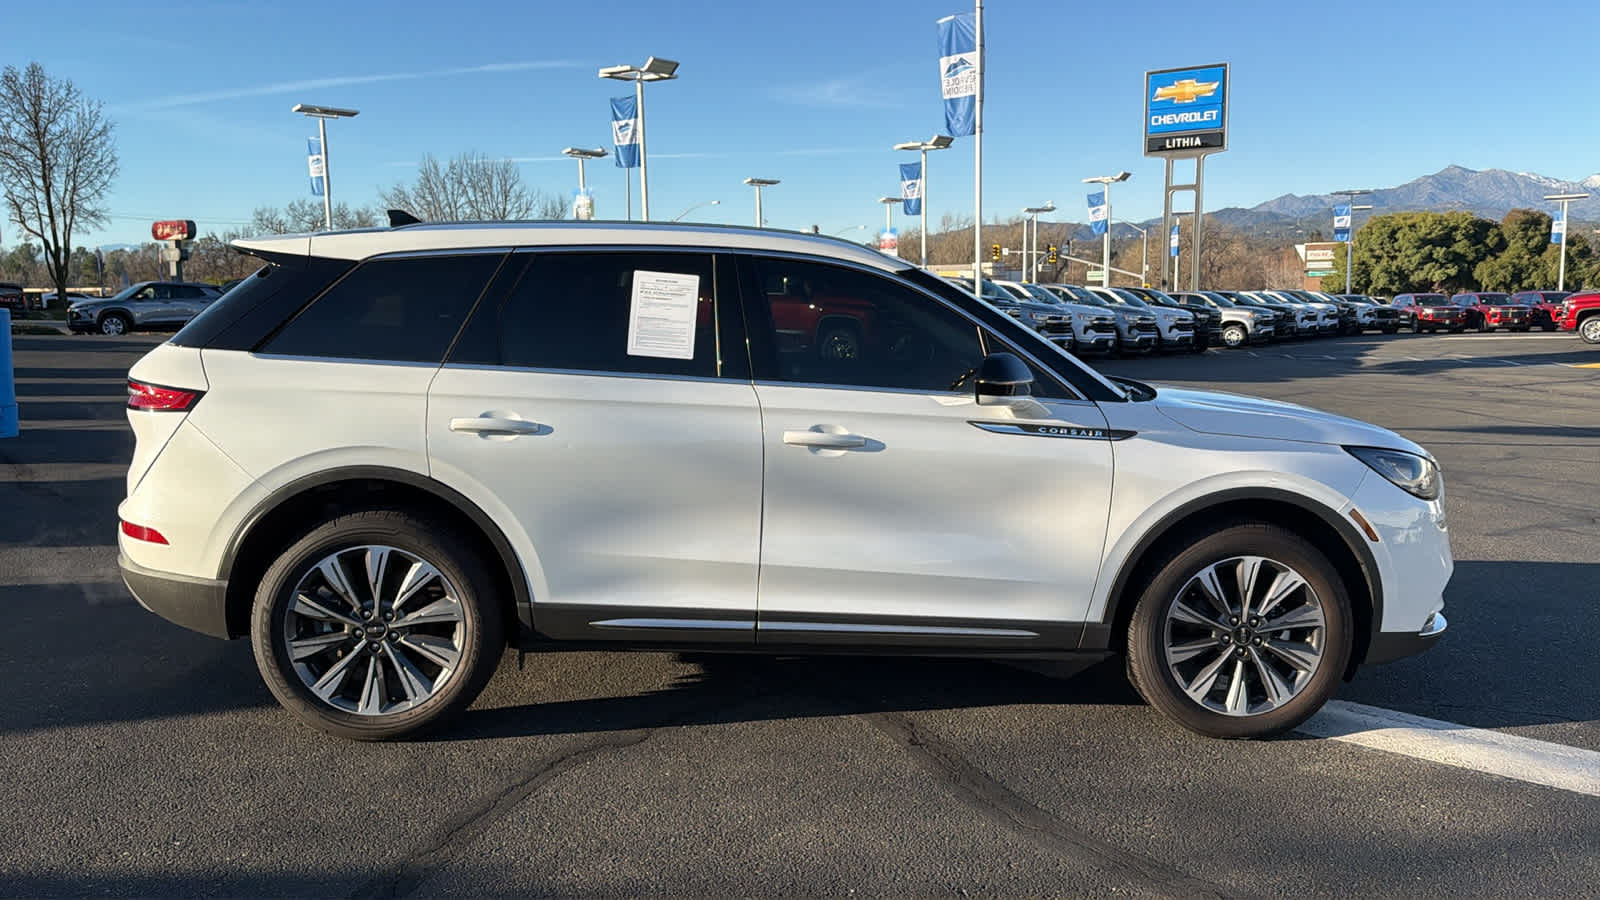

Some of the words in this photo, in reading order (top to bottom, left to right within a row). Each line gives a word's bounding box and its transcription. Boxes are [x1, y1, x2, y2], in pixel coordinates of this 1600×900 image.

[1151, 110, 1218, 126] CHEVROLET
[1166, 137, 1201, 148] LITHIA
[1038, 427, 1103, 437] CORSAIR
